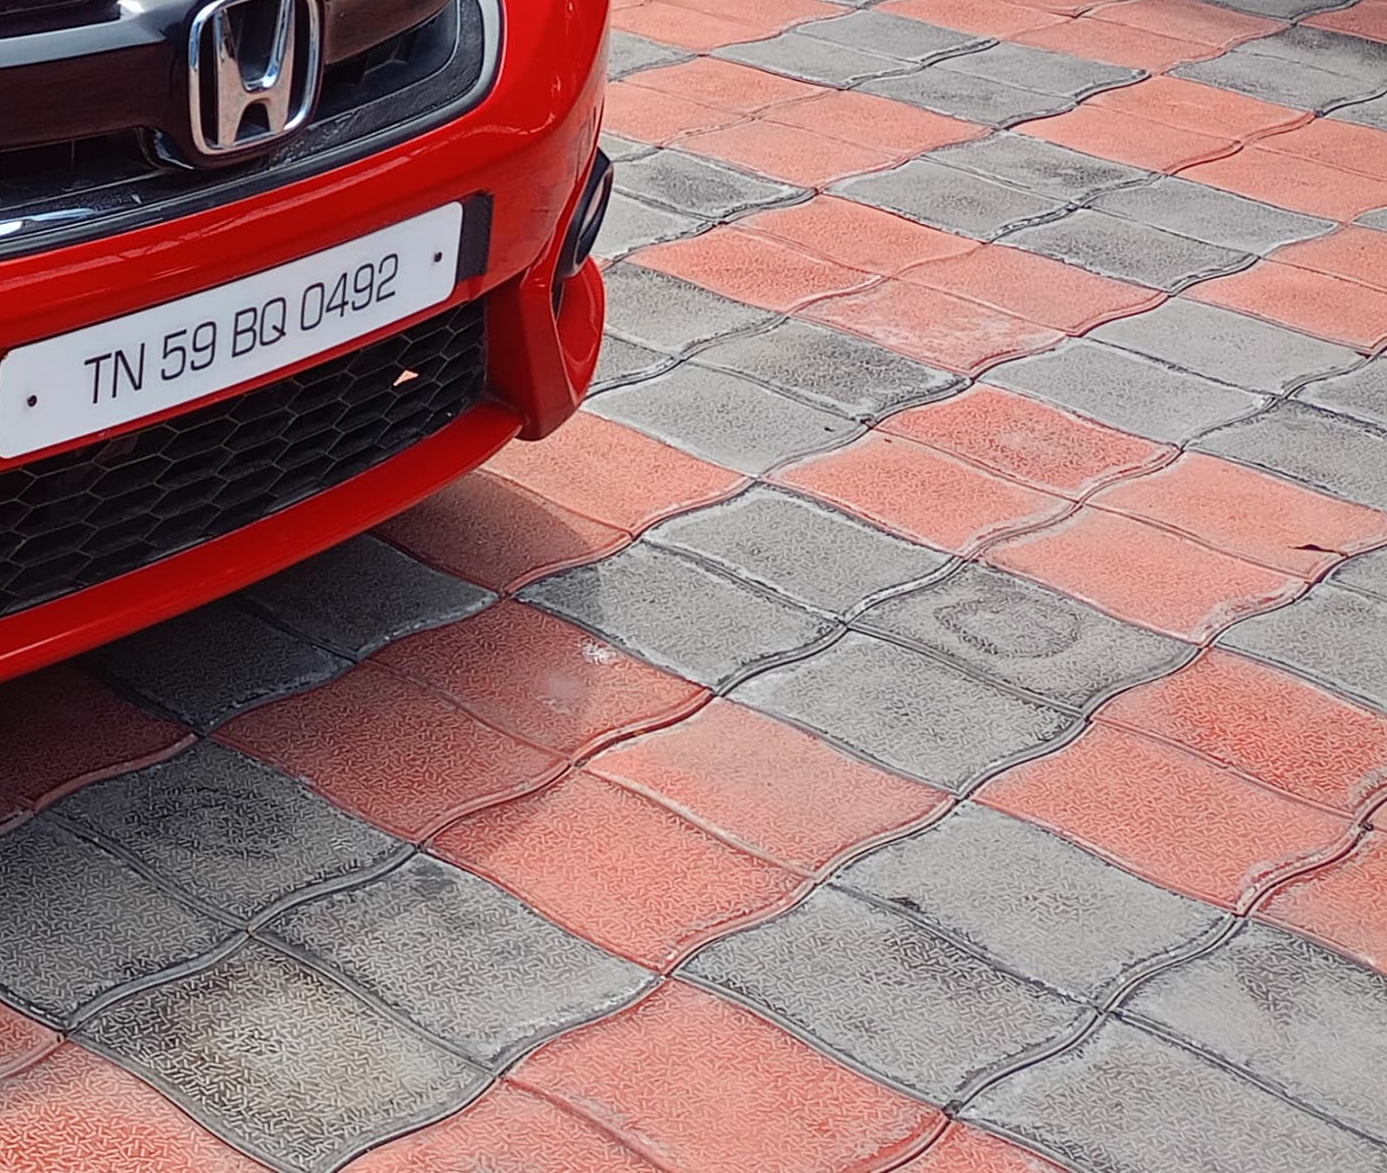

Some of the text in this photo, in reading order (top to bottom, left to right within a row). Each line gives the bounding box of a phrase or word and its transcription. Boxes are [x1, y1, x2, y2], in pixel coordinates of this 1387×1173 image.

[84, 253, 399, 404] TN 59 BQ 0492
